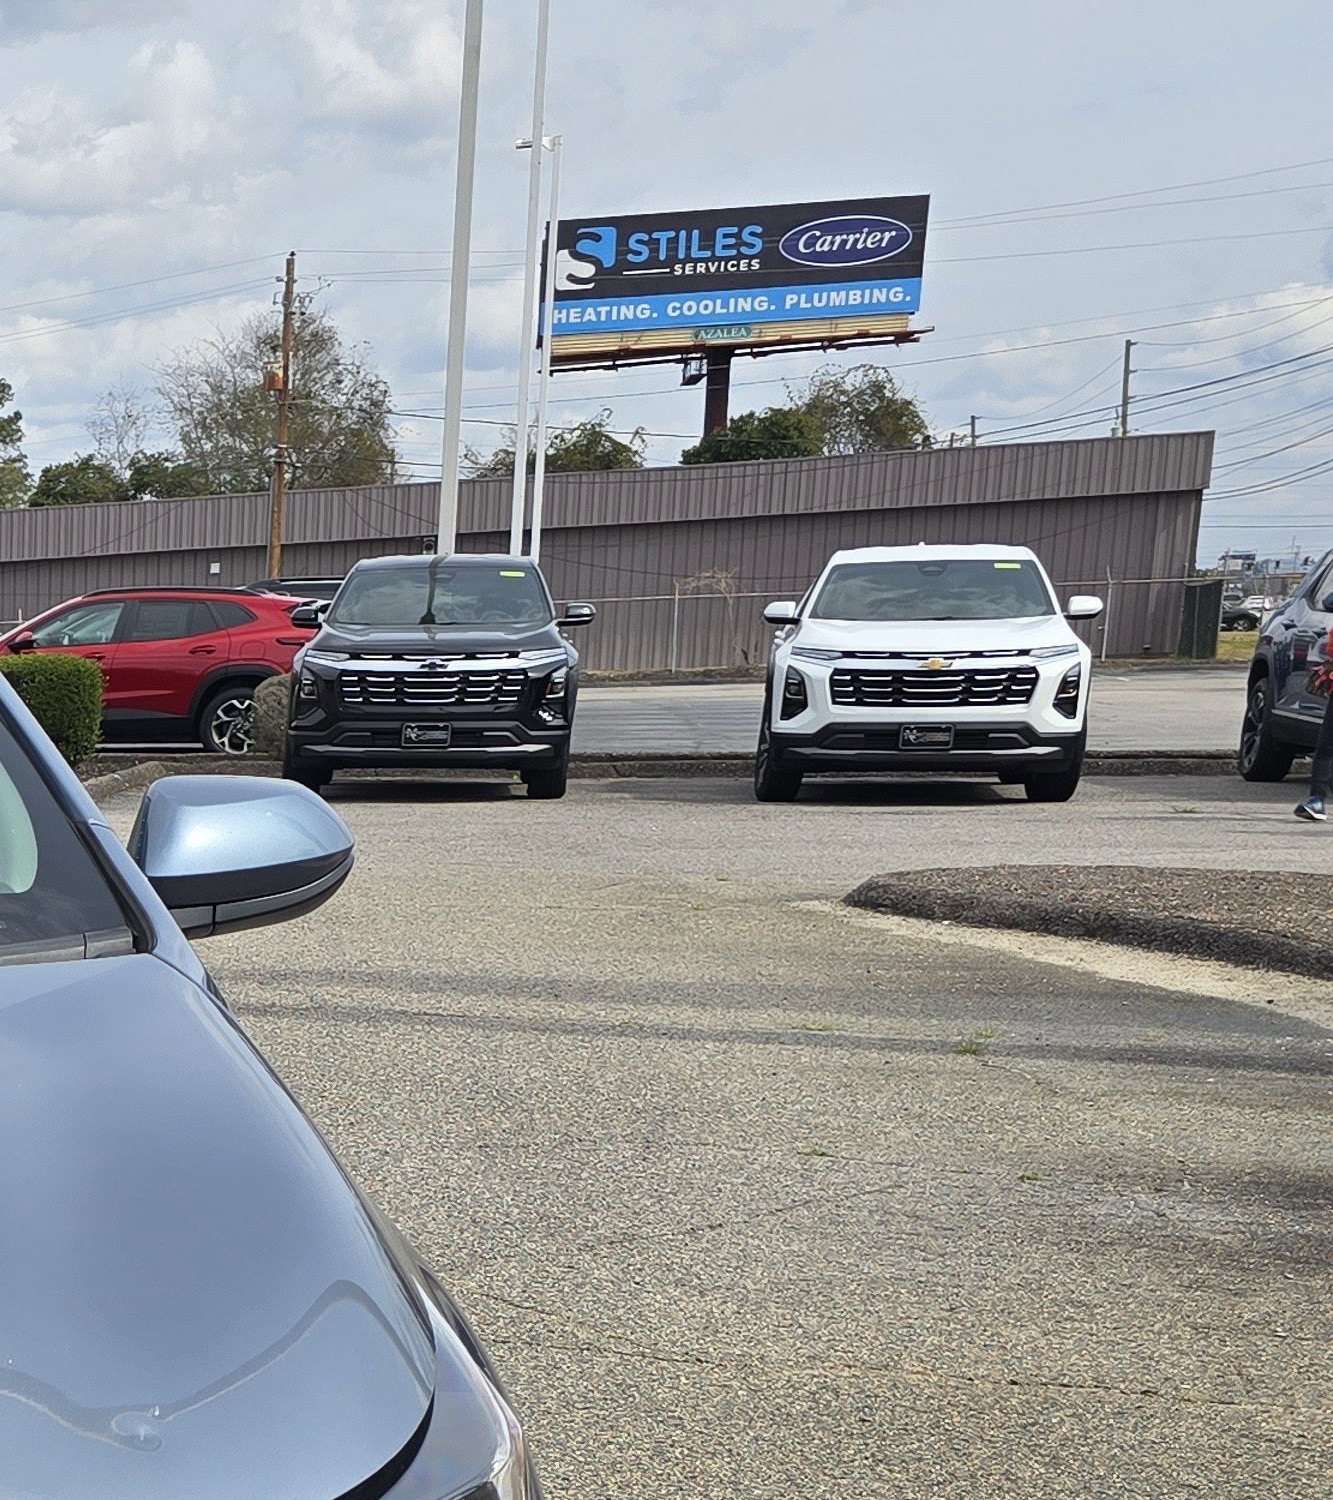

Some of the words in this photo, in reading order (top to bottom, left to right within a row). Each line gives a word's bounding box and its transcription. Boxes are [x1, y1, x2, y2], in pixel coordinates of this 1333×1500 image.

[626, 224, 763, 263] STILES
[798, 227, 896, 254] Carrier
[673, 258, 761, 276] SERVICES
[553, 303, 659, 324] HEATING.
[666, 296, 776, 317] COOLING.
[785, 286, 912, 310] PLUMBING.
[697, 327, 748, 340] AZALEA
